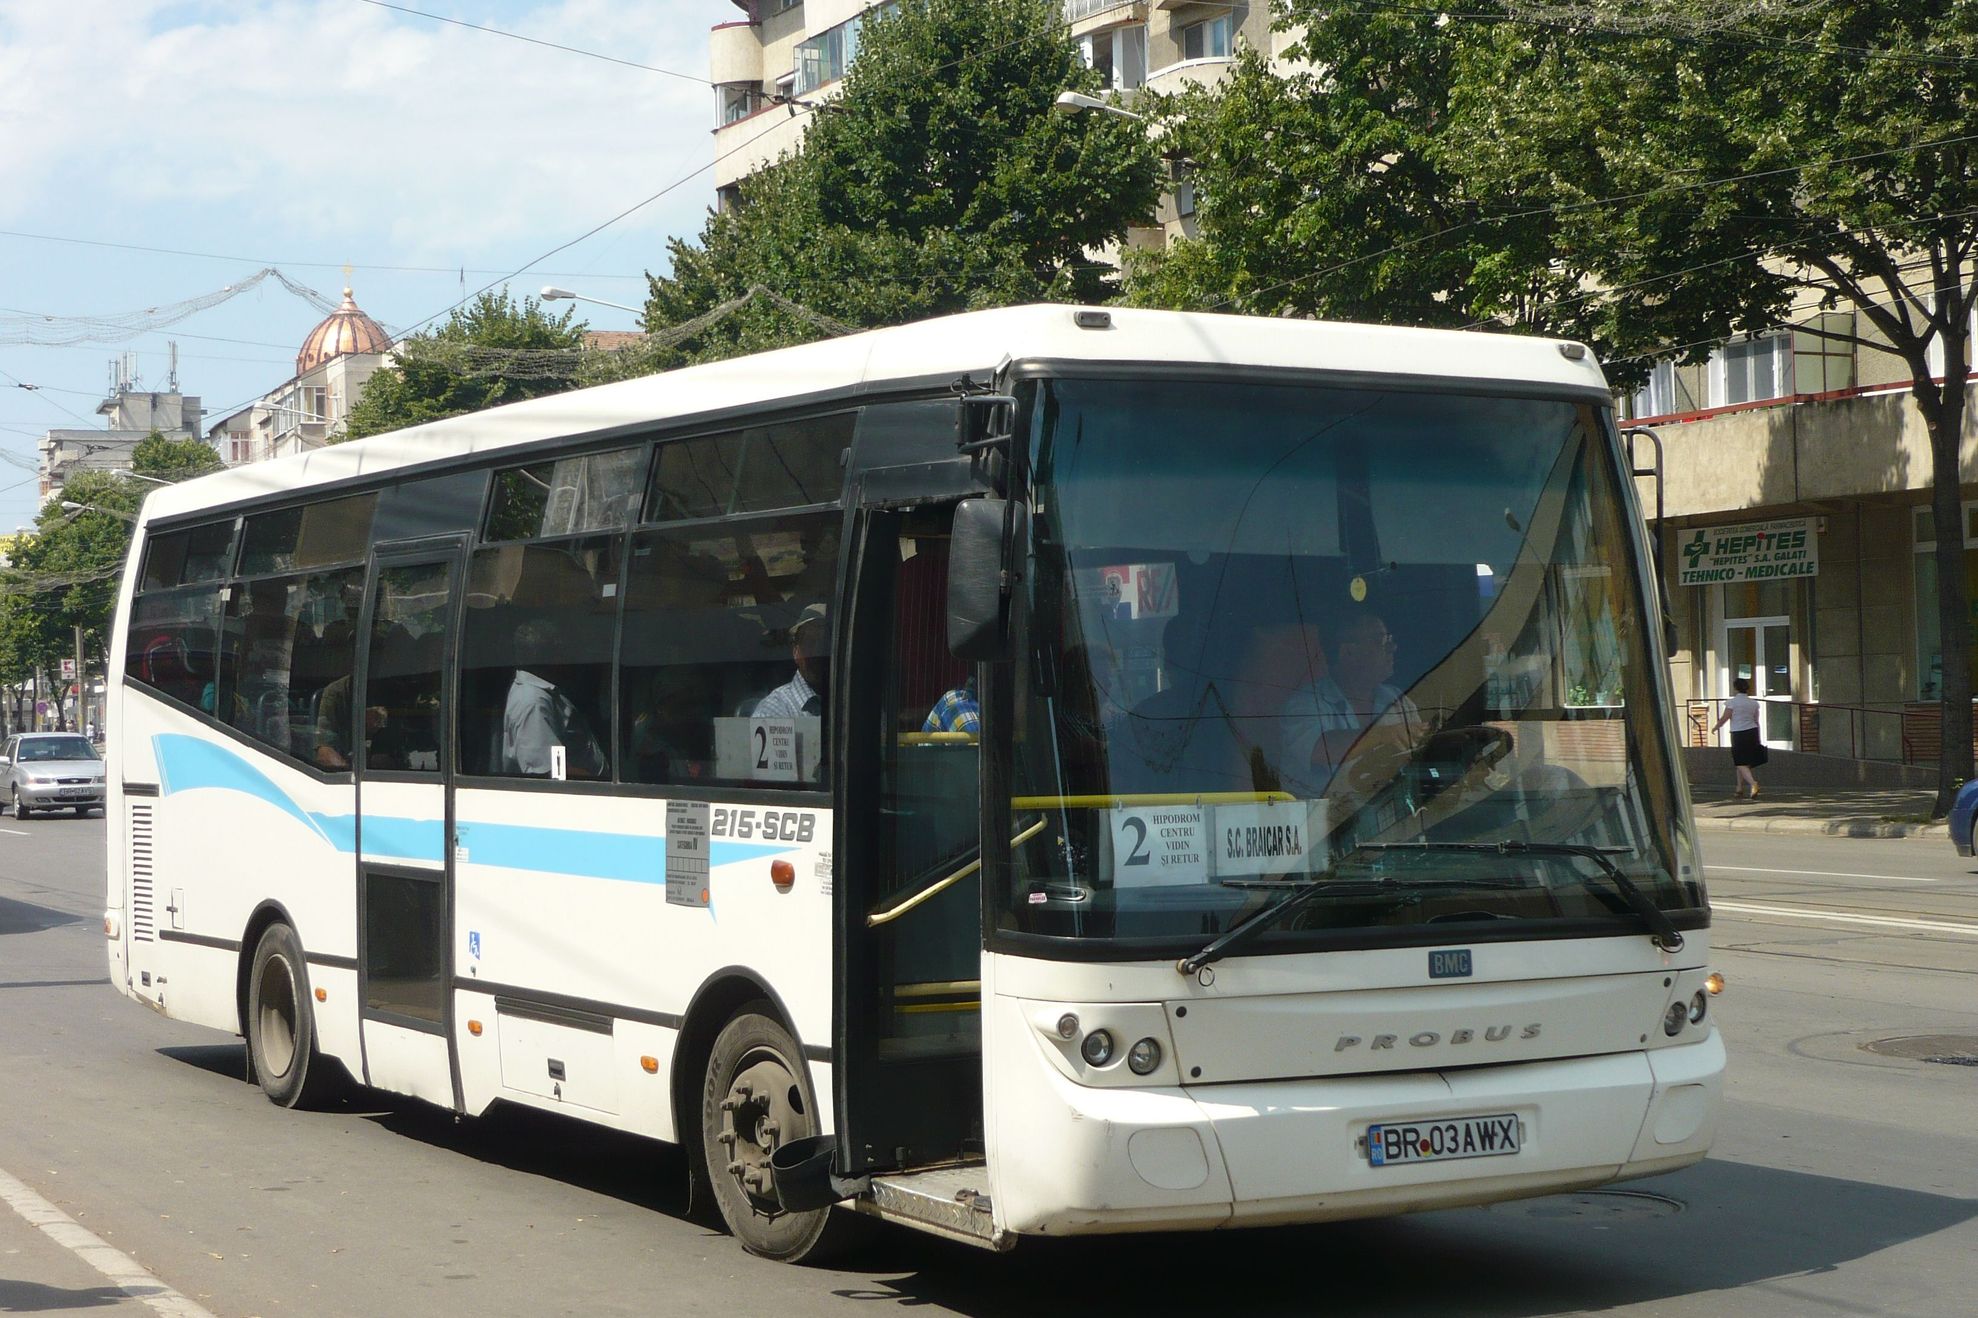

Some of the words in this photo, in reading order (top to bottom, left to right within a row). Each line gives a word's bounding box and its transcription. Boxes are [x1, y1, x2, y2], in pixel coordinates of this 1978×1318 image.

[1754, 554, 1770, 563] S.A.
[1682, 568, 1735, 583] TEHNICO
[1745, 561, 1815, 579] MEDICALE
[755, 726, 768, 769] 2
[1153, 813, 1200, 825] HIPODROM
[1121, 816, 1151, 866] 2
[1160, 827, 1195, 838] CENTRU
[1227, 827, 1243, 858] S.C.
[1246, 826, 1284, 857] BRAICAR
[1285, 825, 1302, 855] S.A.
[1165, 840, 1190, 850] VIDIN
[1171, 854, 1200, 864] RETUR
[1434, 953, 1468, 974] BMC
[1334, 1023, 1542, 1052] PROBUS
